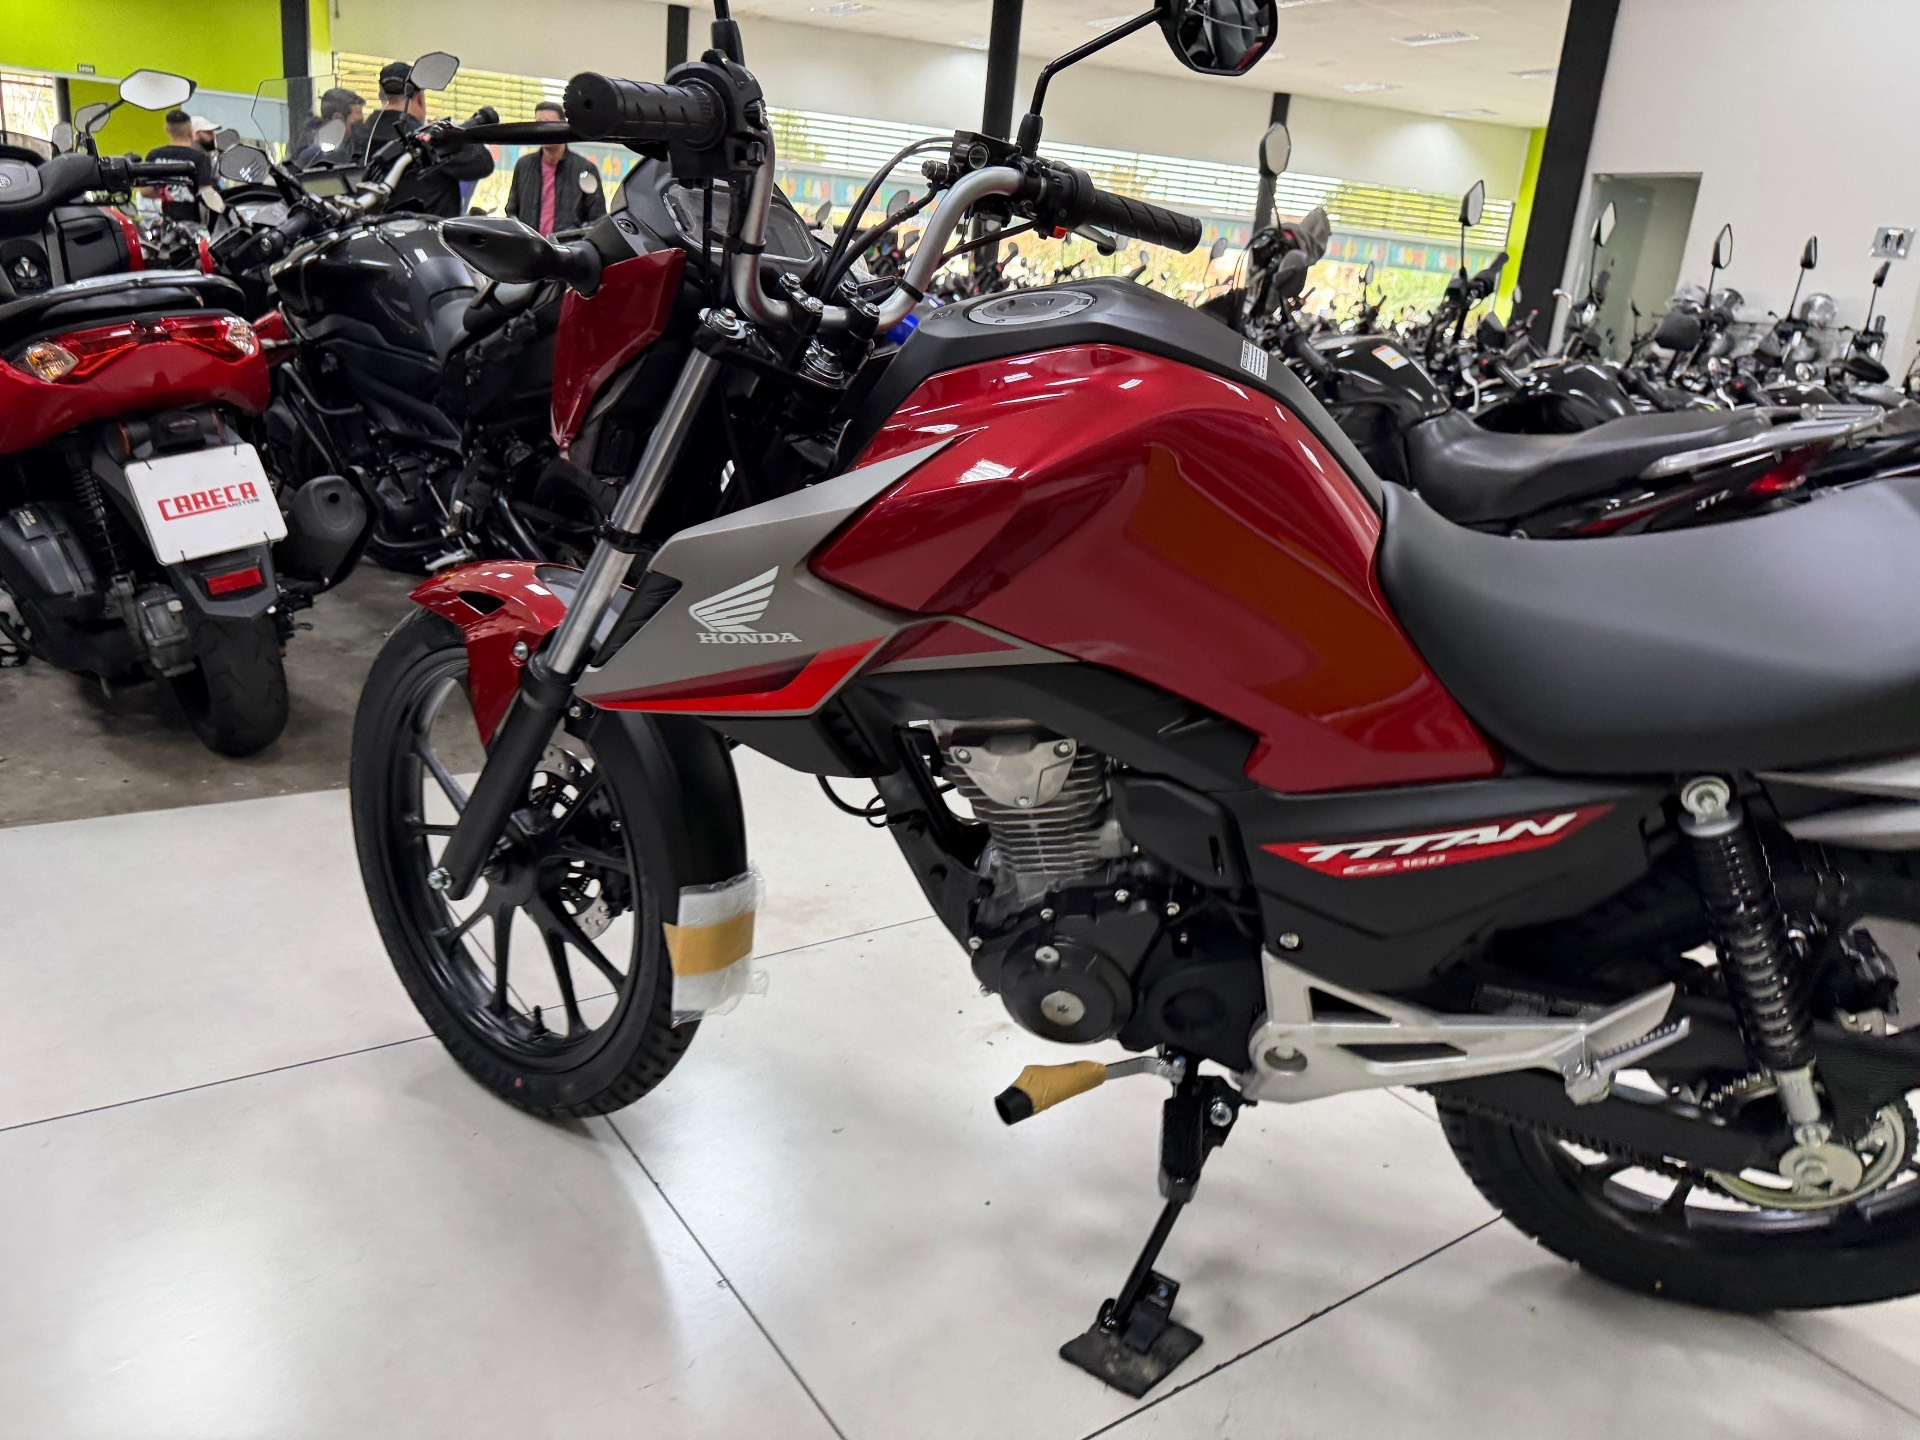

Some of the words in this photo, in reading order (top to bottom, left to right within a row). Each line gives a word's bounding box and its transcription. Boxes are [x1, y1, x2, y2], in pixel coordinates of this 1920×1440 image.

[157, 481, 258, 522] CARECA
[696, 632, 803, 644] HONDA
[1299, 811, 1578, 863] TITAN
[1402, 853, 1446, 870] 160
